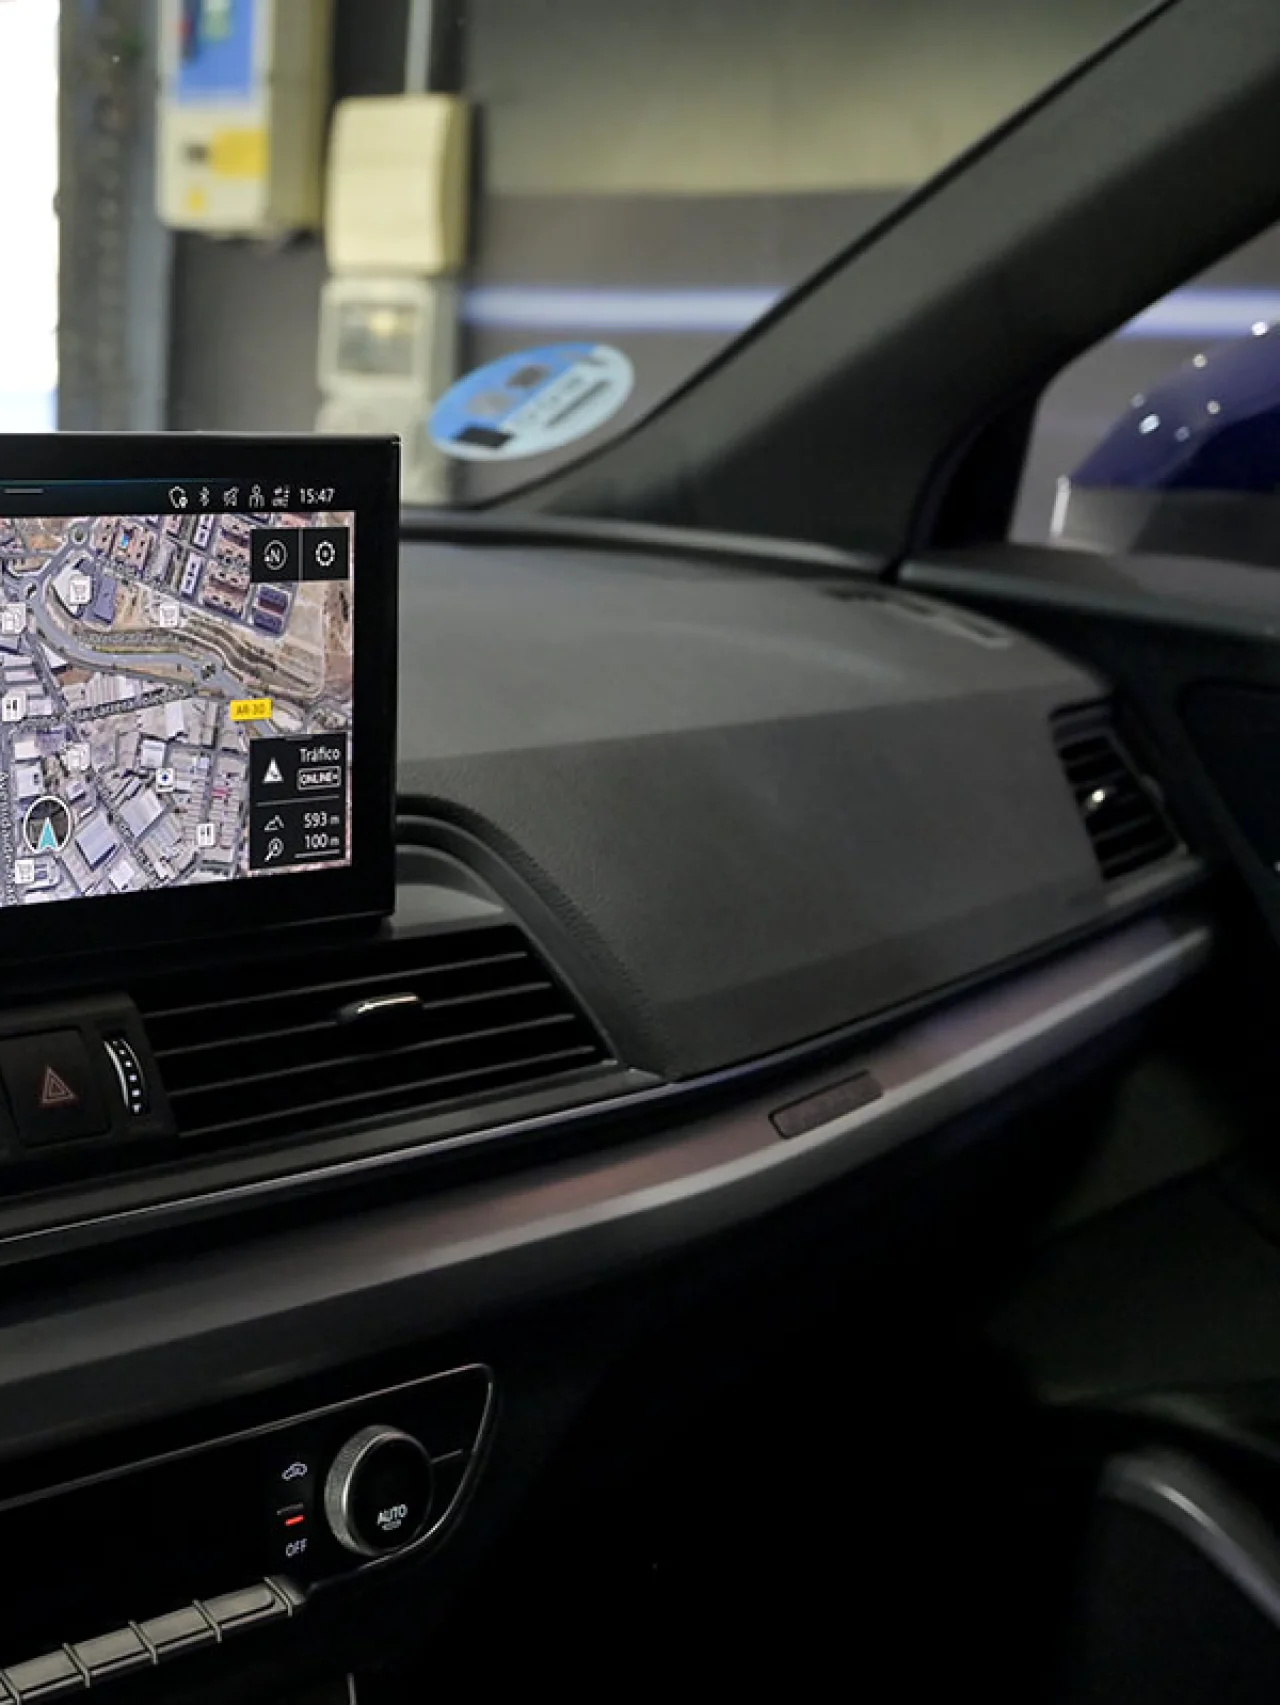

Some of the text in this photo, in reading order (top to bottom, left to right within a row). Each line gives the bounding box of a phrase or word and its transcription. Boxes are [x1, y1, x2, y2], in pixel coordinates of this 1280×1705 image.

[300, 487, 335, 504] 15:47
[299, 746, 340, 763] Tráfico
[303, 811, 328, 828] 593
[304, 832, 328, 849] 100
[377, 1504, 408, 1525] AUTO
[285, 1538, 307, 1557] OFF
